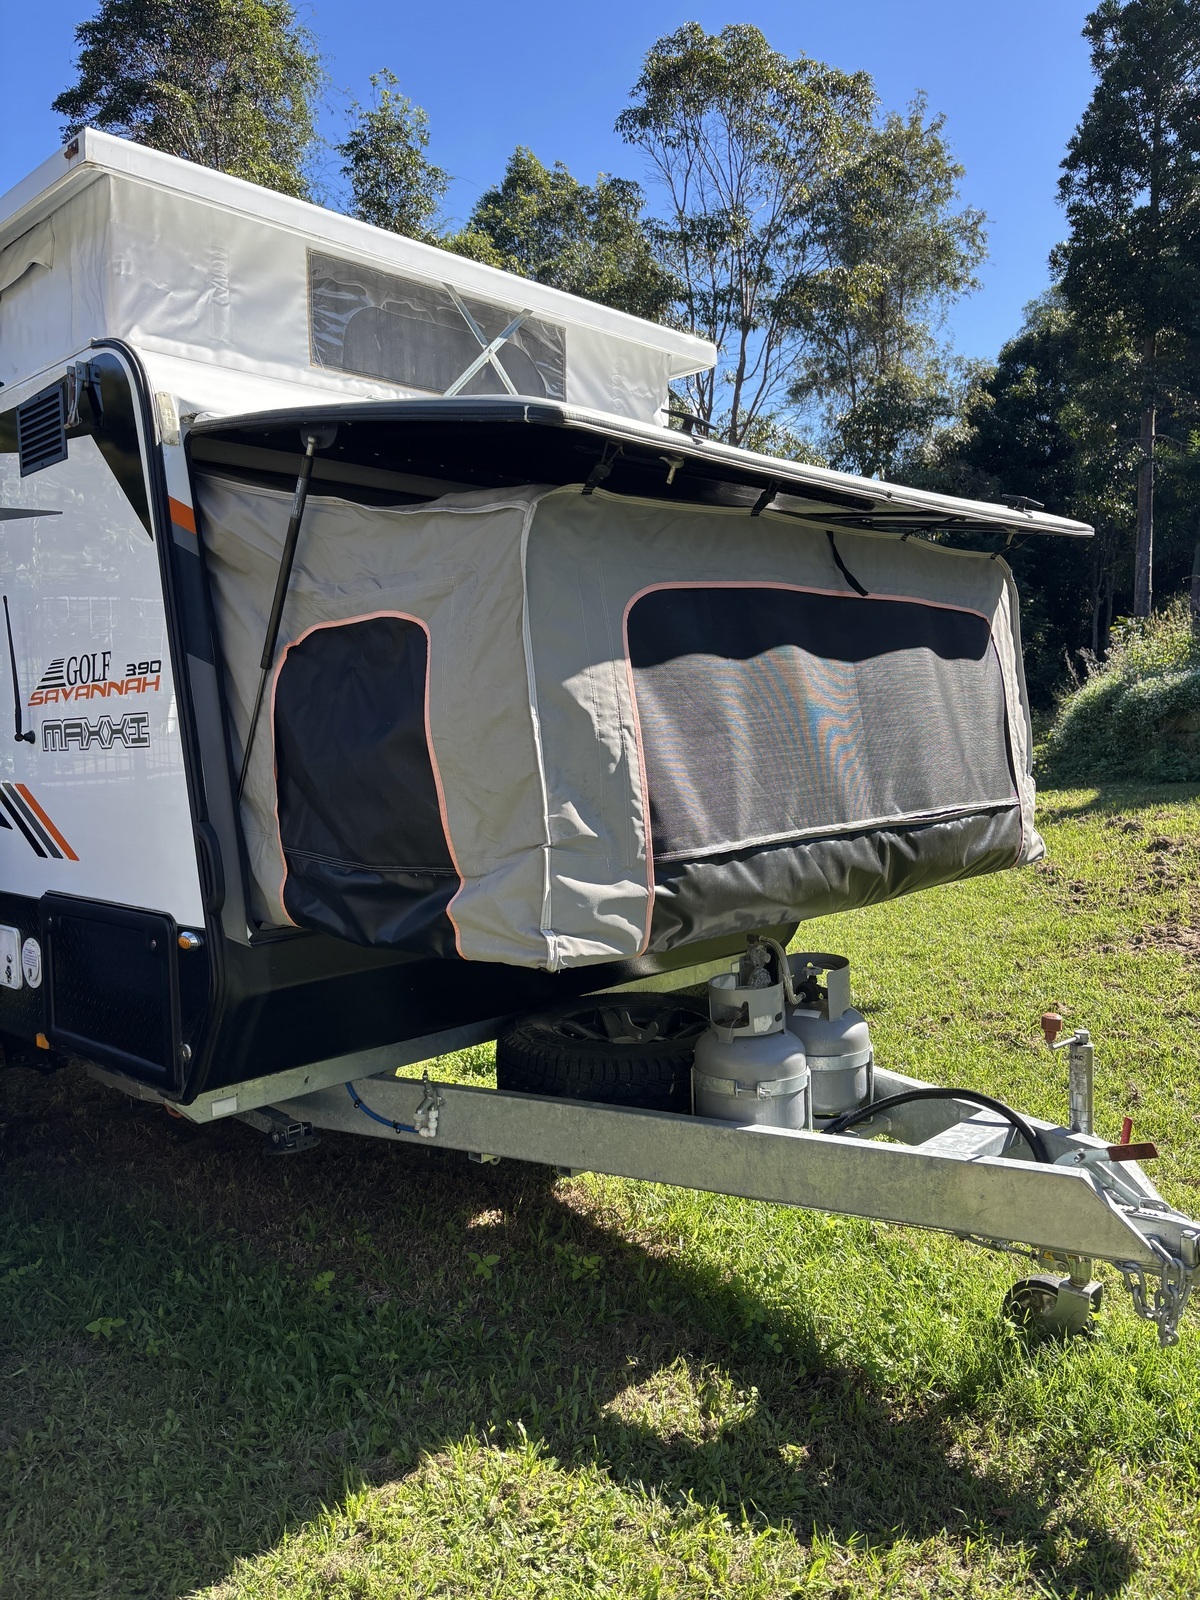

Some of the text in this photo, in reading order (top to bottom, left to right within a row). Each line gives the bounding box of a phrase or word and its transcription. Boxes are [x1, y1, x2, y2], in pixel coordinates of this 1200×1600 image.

[66, 651, 162, 686] GOLF 390
[28, 675, 160, 706] SAVANNAH
[42, 712, 150, 751] MAXXI
